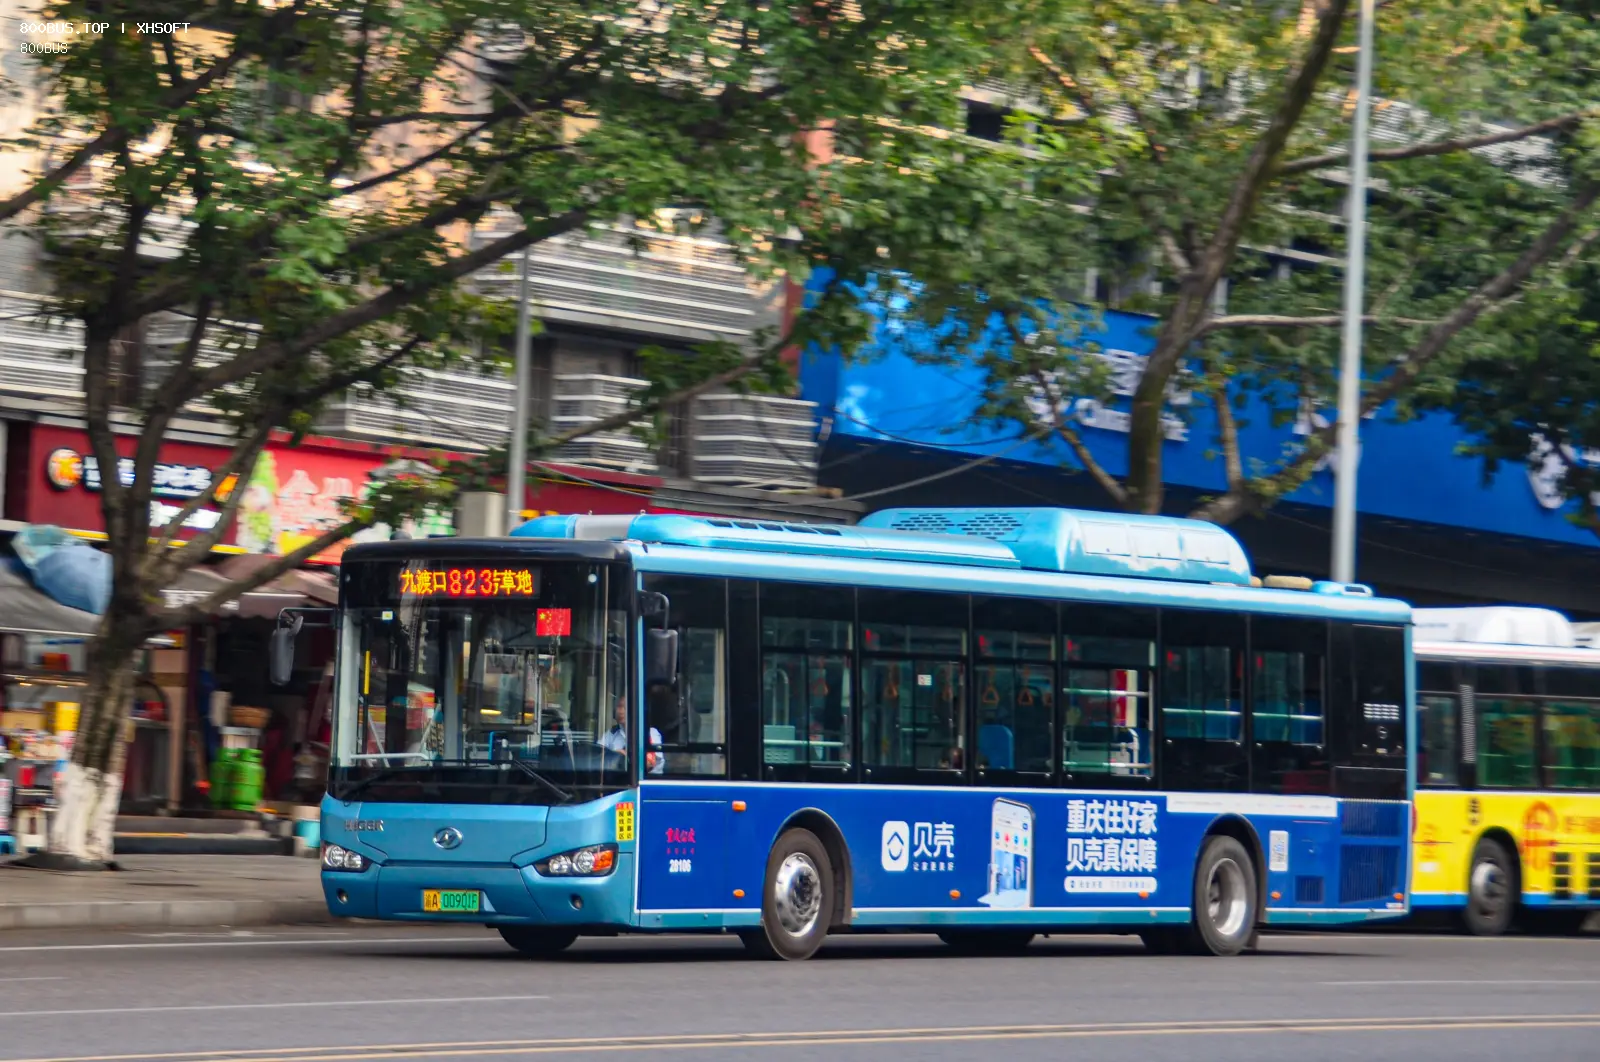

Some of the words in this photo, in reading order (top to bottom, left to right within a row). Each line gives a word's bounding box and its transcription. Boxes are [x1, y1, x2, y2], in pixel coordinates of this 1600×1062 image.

[1066, 799, 1158, 834] 重庆住好家
[913, 821, 955, 858] 贝壳
[1065, 837, 1158, 872] 贝壳真保障
